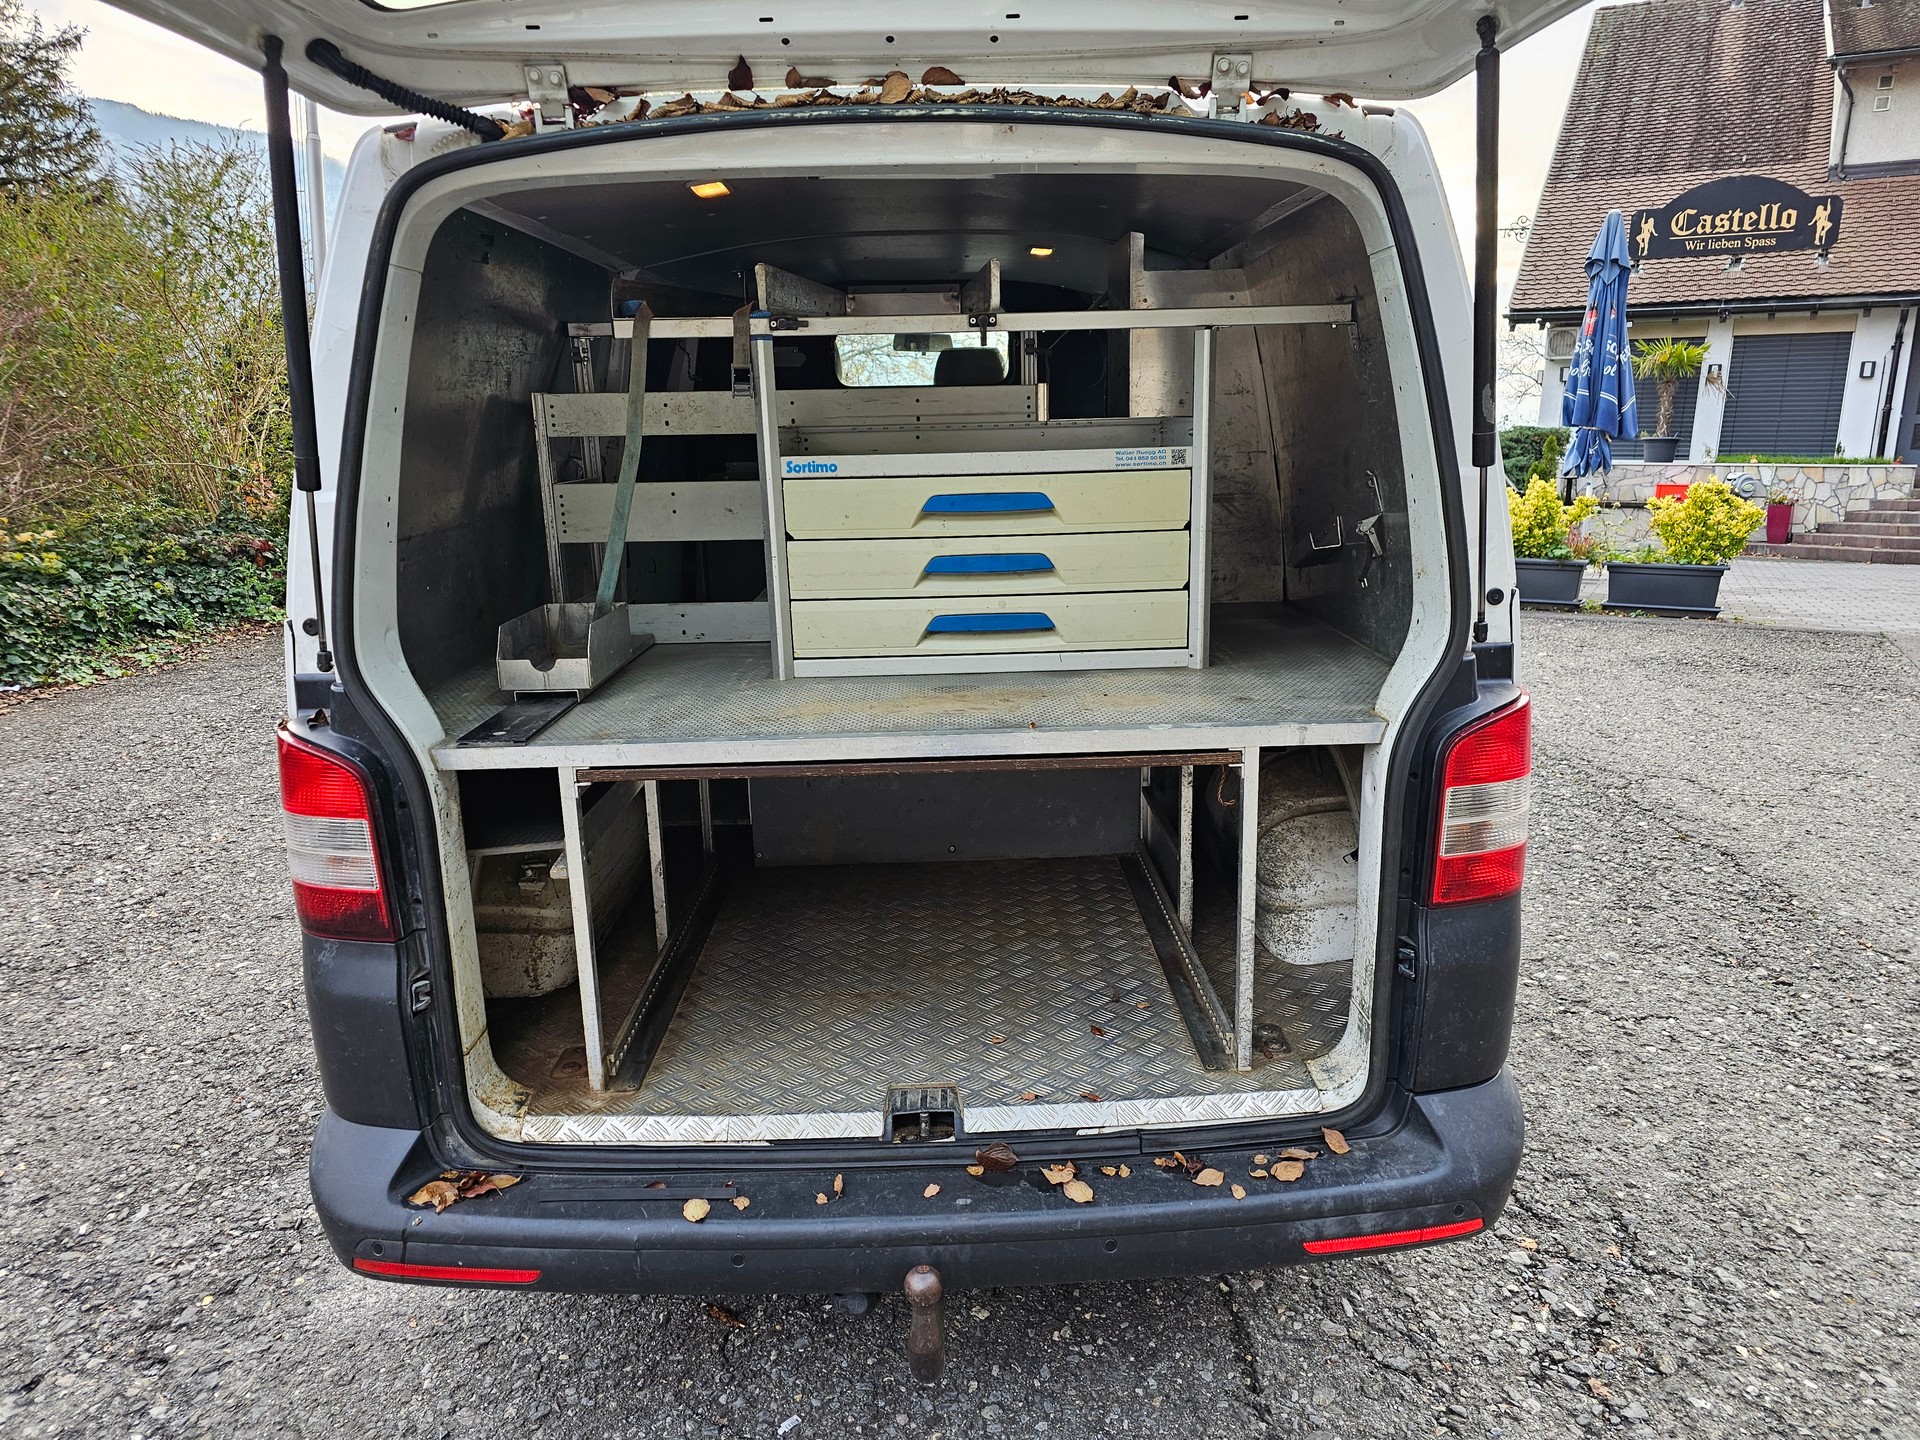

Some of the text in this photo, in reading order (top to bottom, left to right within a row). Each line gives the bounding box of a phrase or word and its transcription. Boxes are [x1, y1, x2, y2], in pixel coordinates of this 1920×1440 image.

[1670, 202, 1798, 236] Castello
[1684, 236, 1777, 251] Wir lieben Spass
[786, 460, 838, 474] Sortimo
